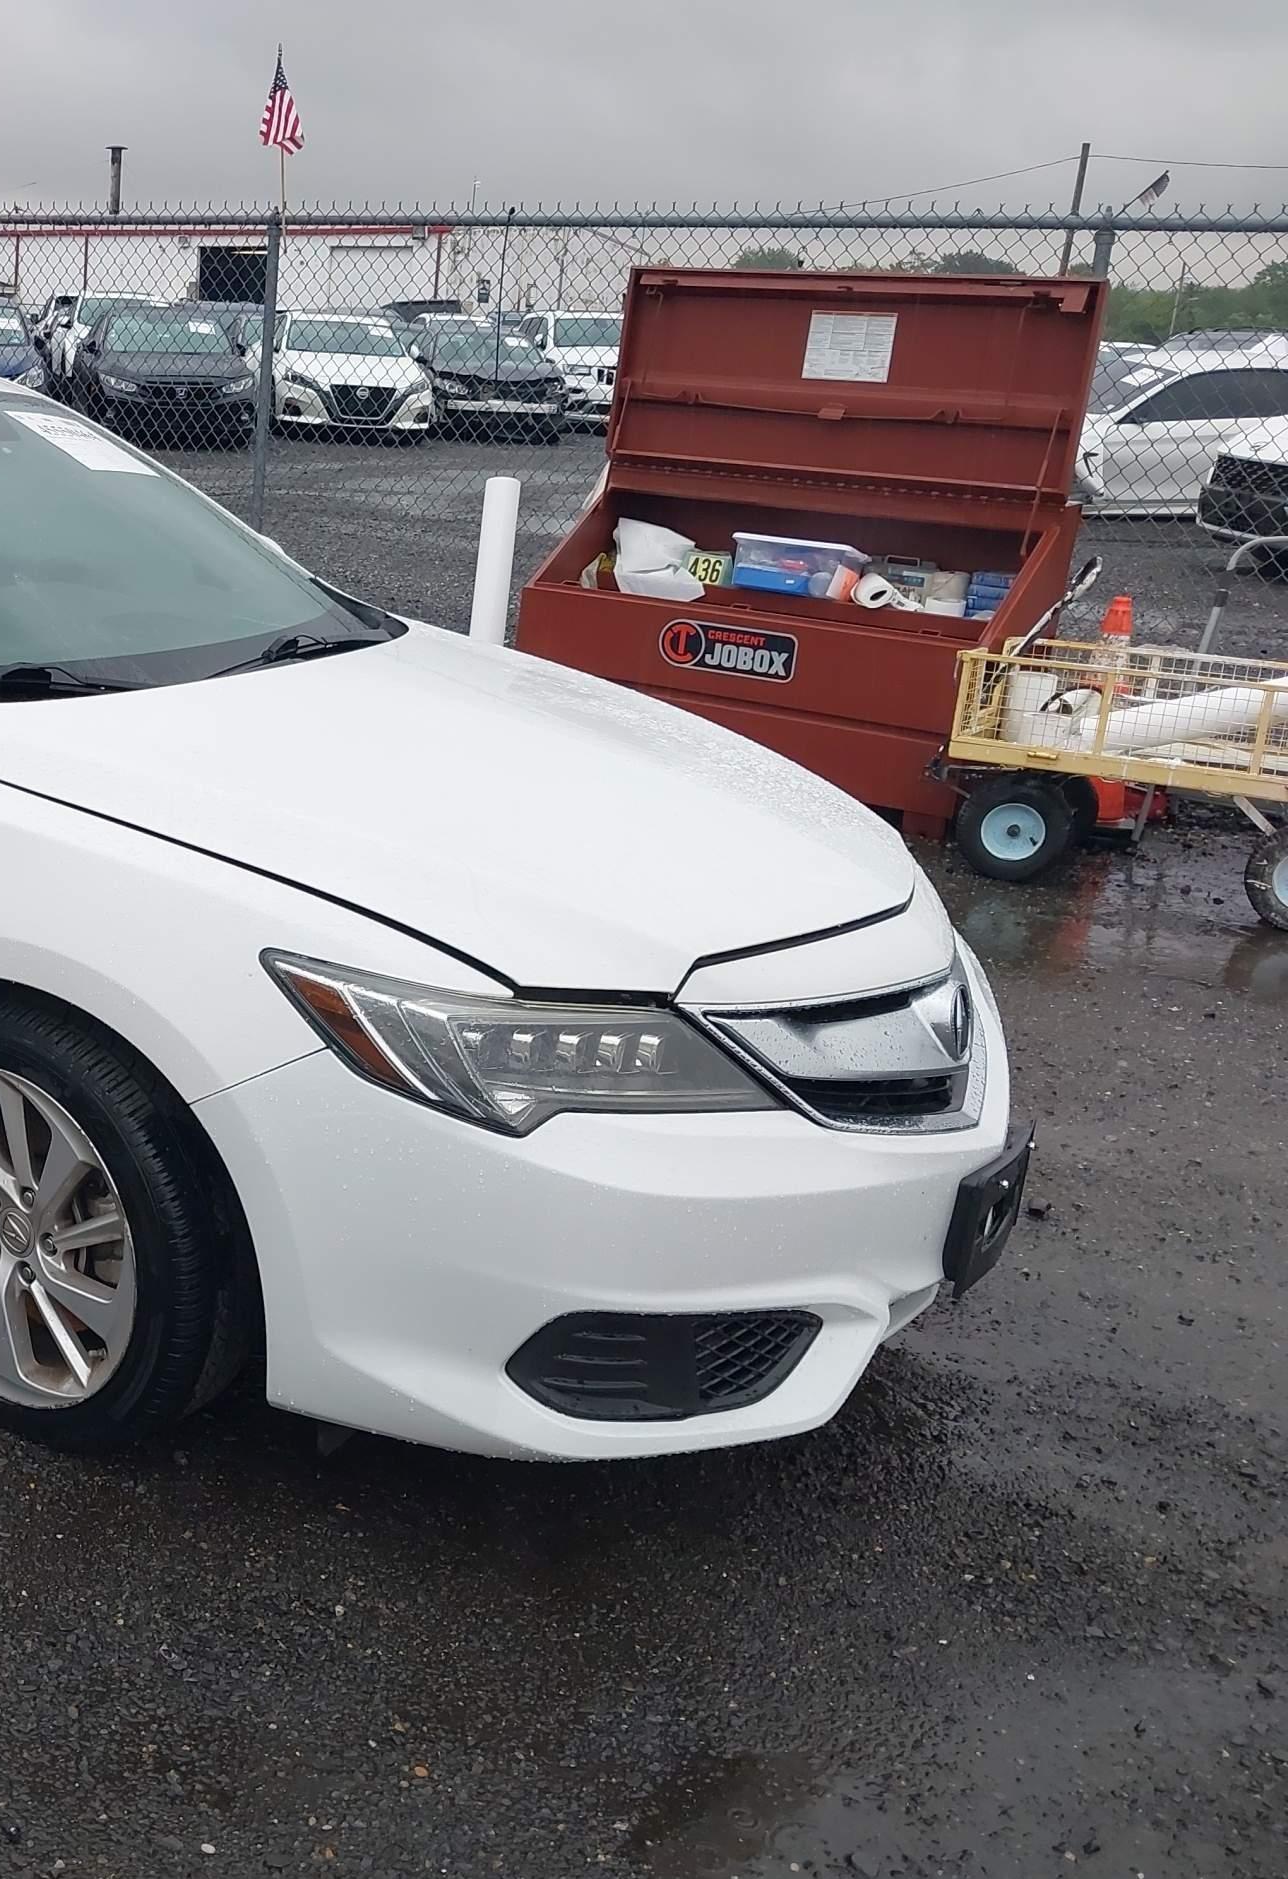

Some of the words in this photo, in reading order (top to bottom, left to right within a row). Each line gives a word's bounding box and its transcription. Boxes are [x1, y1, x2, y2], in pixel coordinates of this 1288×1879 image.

[688, 557, 723, 583] 436
[707, 629, 766, 647] CRESCENT
[704, 642, 790, 677] JOBOX
